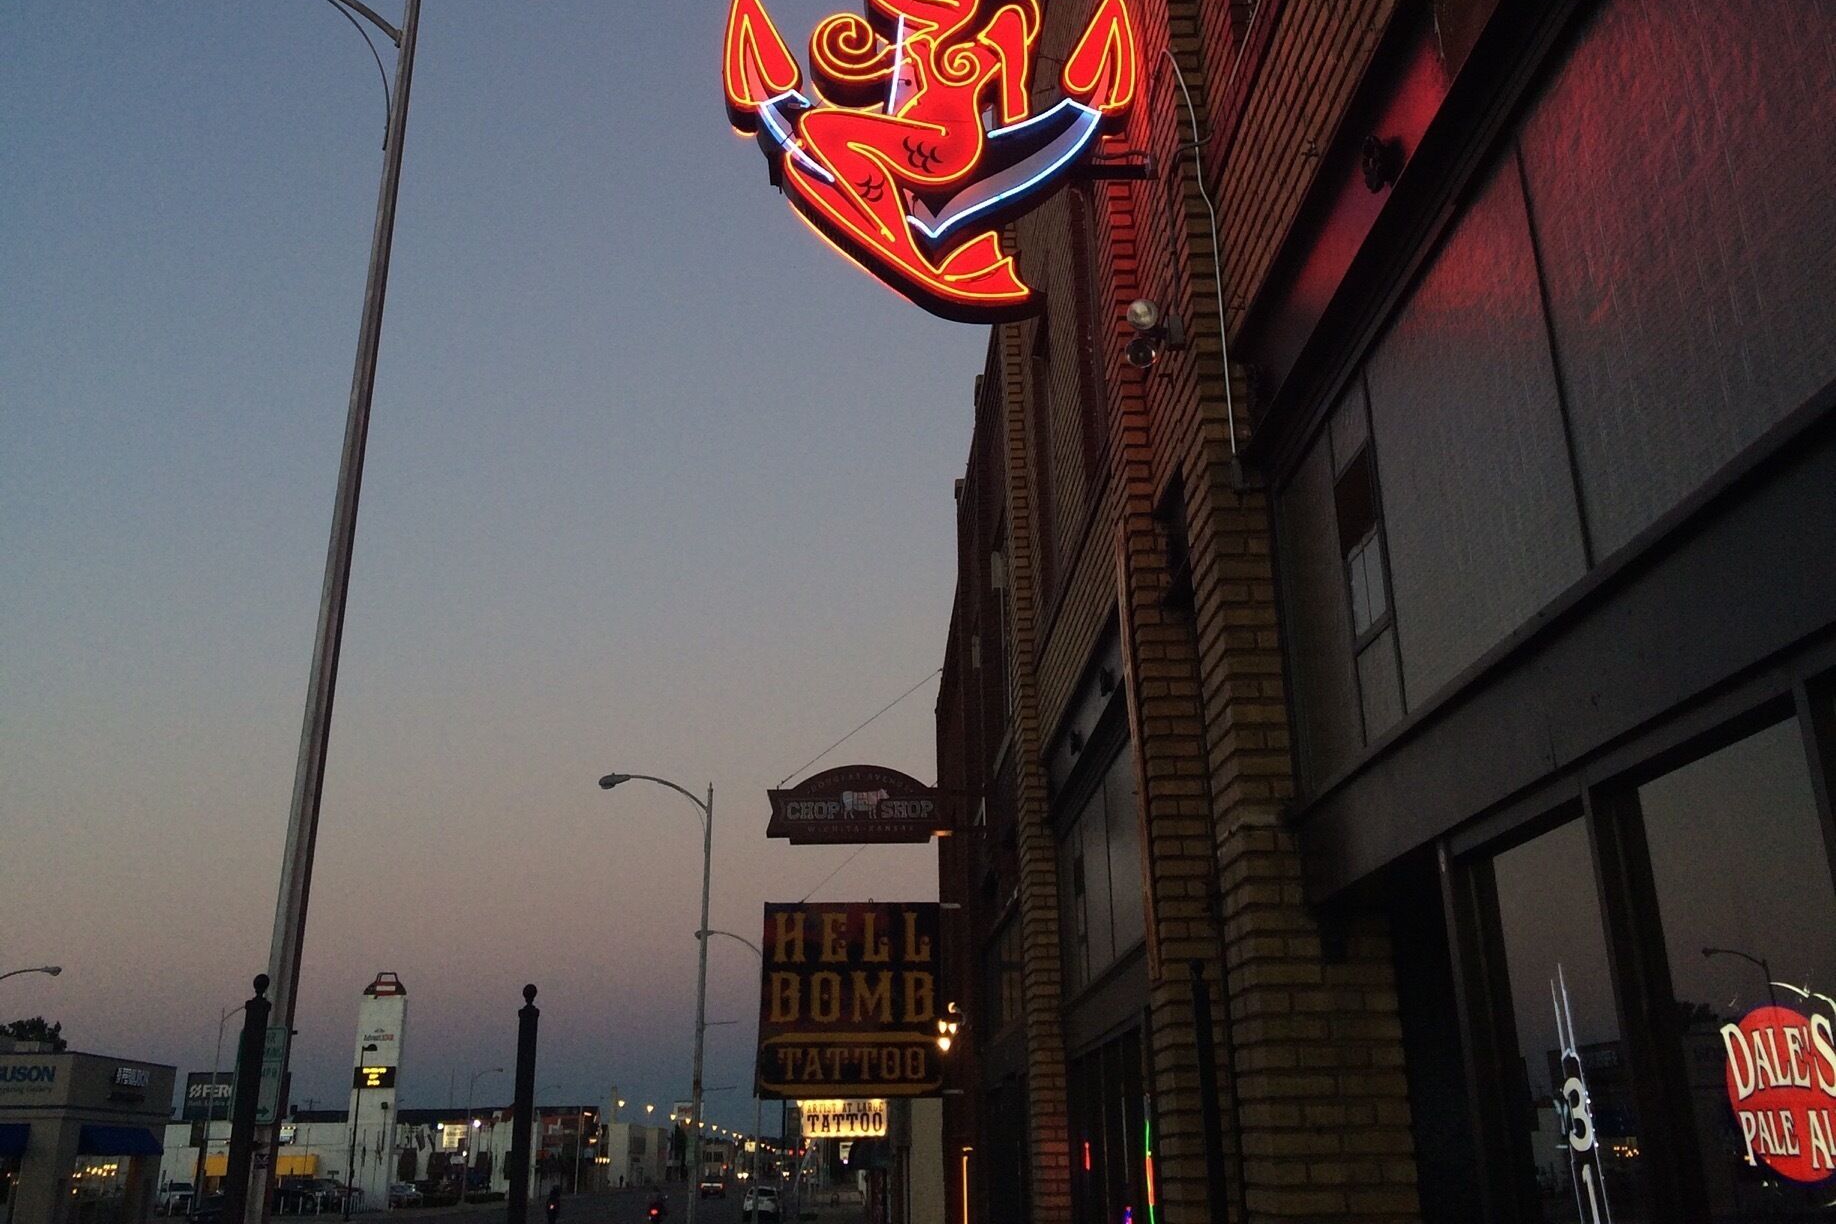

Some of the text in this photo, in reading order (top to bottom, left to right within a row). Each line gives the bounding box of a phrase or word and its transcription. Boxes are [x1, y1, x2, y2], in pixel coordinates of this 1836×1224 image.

[786, 799, 934, 821] CHOP SHOP
[773, 912, 932, 964] HELL
[770, 969, 935, 1024] BOMB
[778, 1047, 926, 1081] TATTOO
[1719, 1012, 1836, 1101] DALE'S
[807, 1113, 883, 1132] TATTOO
[842, 1103, 853, 1113] AT
[857, 1102, 884, 1113] LARGE
[1737, 1109, 1801, 1167] PALE
